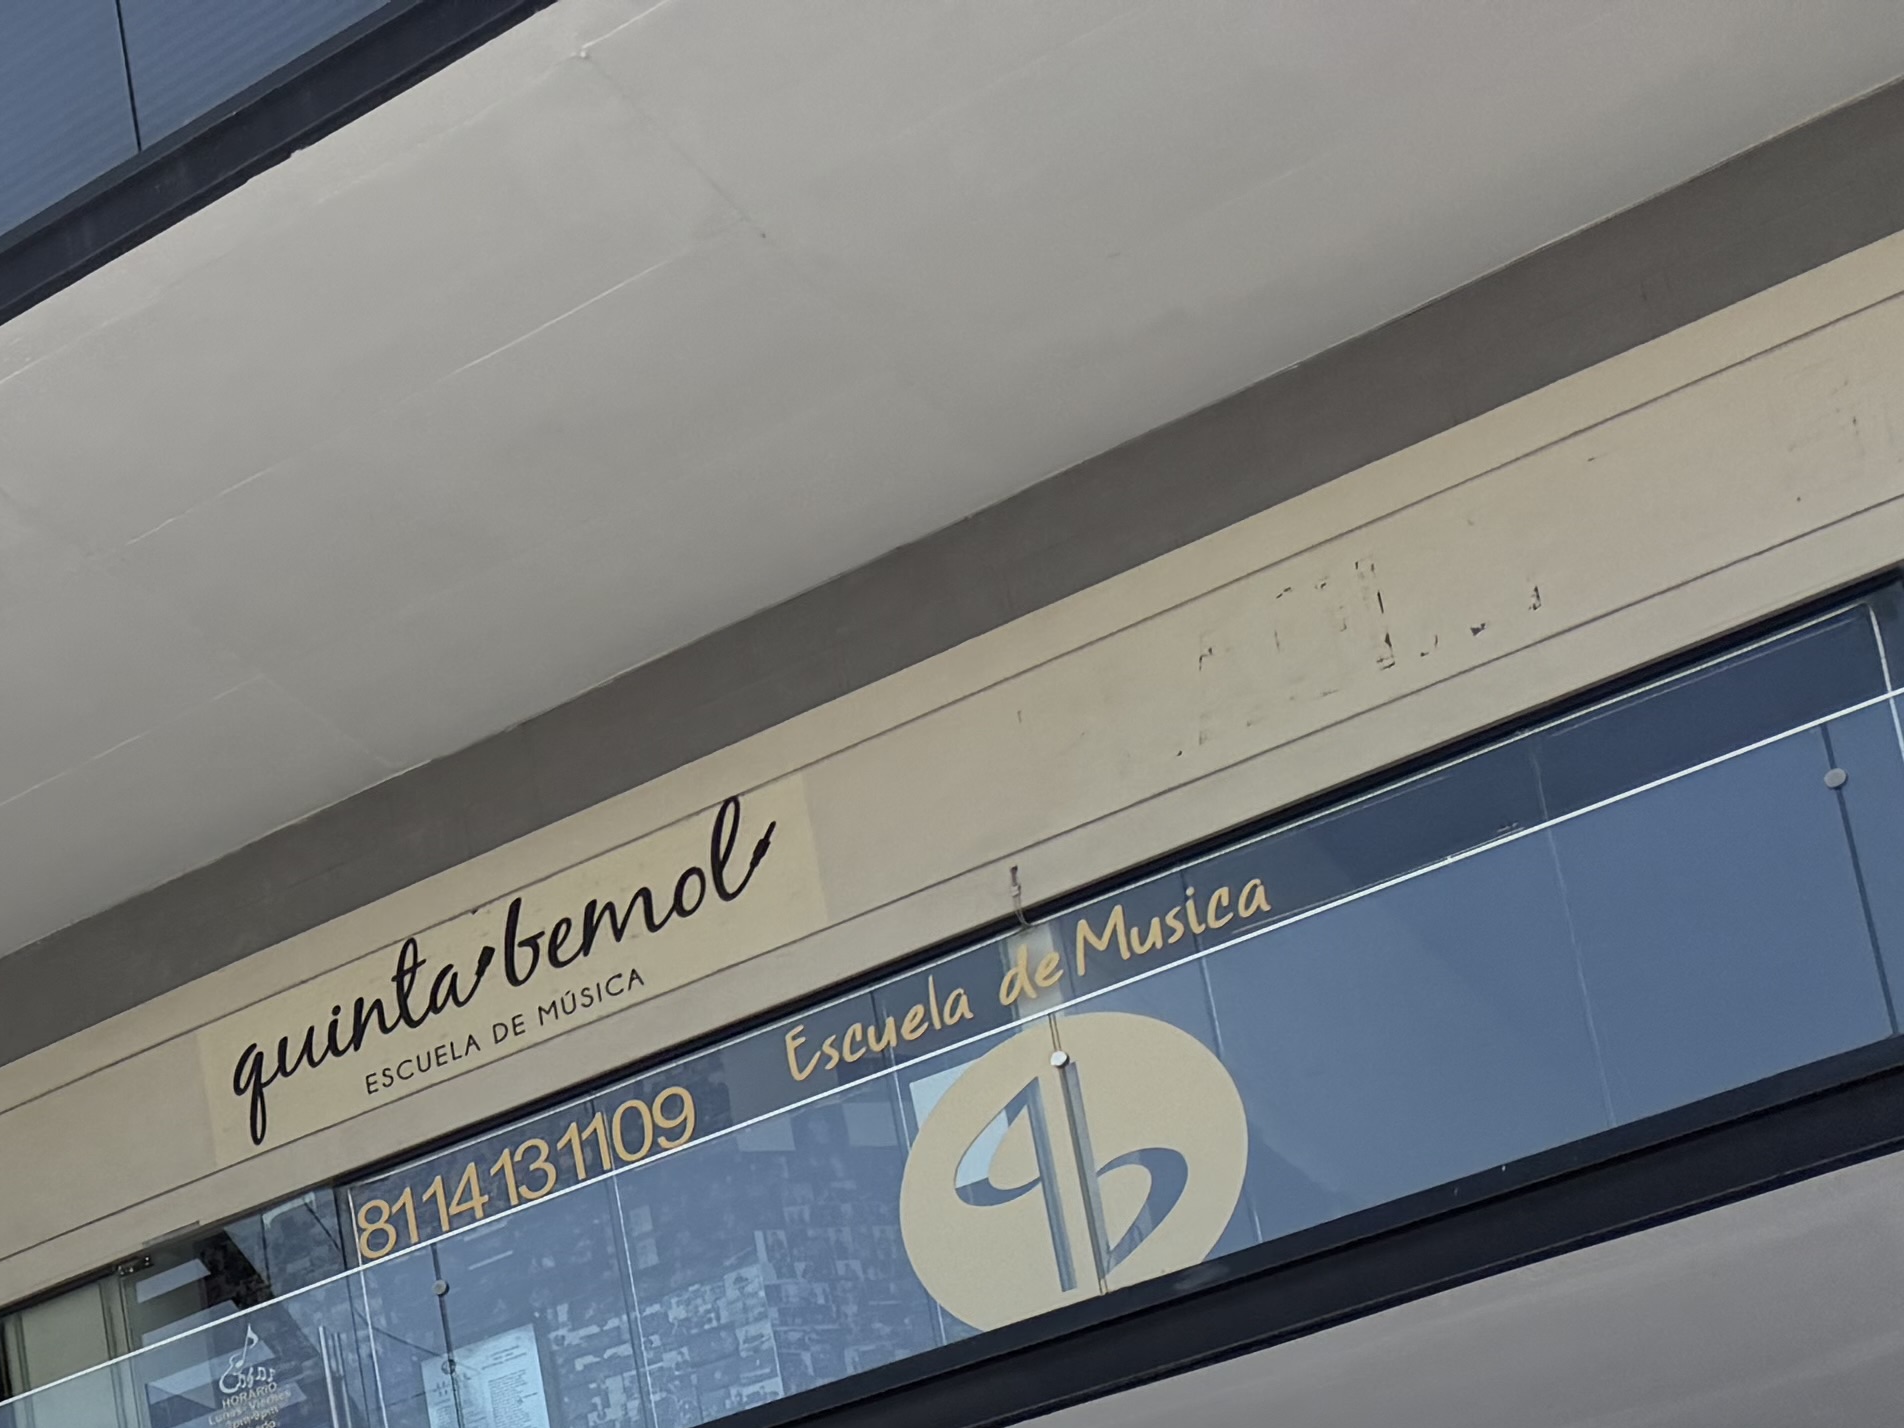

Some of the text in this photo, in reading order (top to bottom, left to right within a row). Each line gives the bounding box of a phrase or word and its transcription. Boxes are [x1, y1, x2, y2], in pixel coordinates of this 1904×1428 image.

[233, 796, 776, 1146] quinta bemol
[366, 968, 645, 1095] ESCUELA DE MÚSICA
[784, 878, 1272, 1082] Escuela de Musica
[357, 1085, 696, 1261] 8114131109
[222, 1381, 278, 1410] HORARIO
